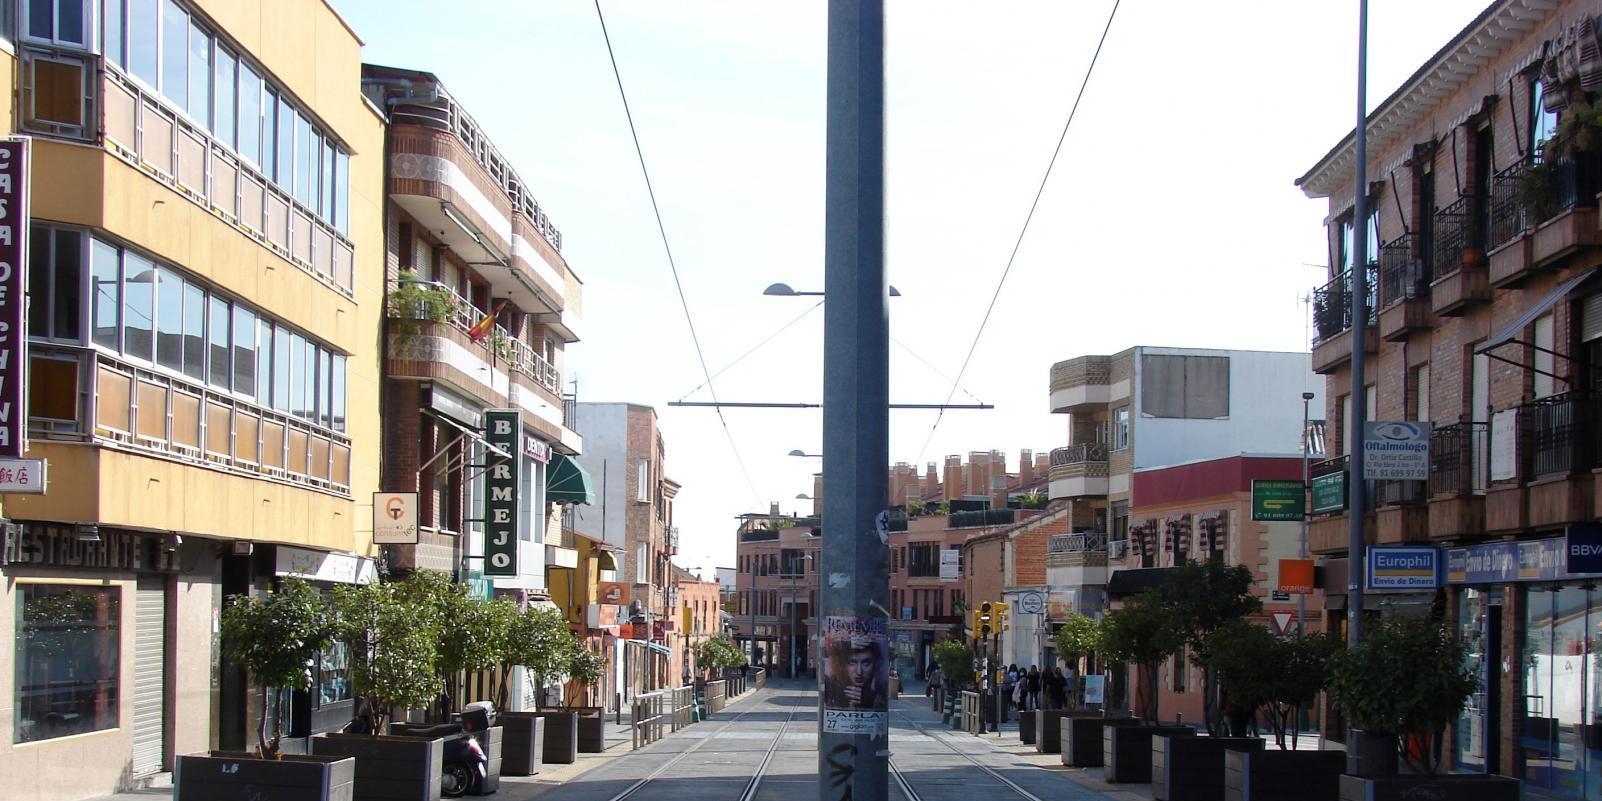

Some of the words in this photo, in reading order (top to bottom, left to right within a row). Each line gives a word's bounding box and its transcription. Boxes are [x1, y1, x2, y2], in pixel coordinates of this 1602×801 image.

[491, 420, 512, 567] BERMEJO
[1377, 556, 1431, 569] Europhil
[826, 711, 880, 719] PARLA
[827, 719, 838, 729] 27
